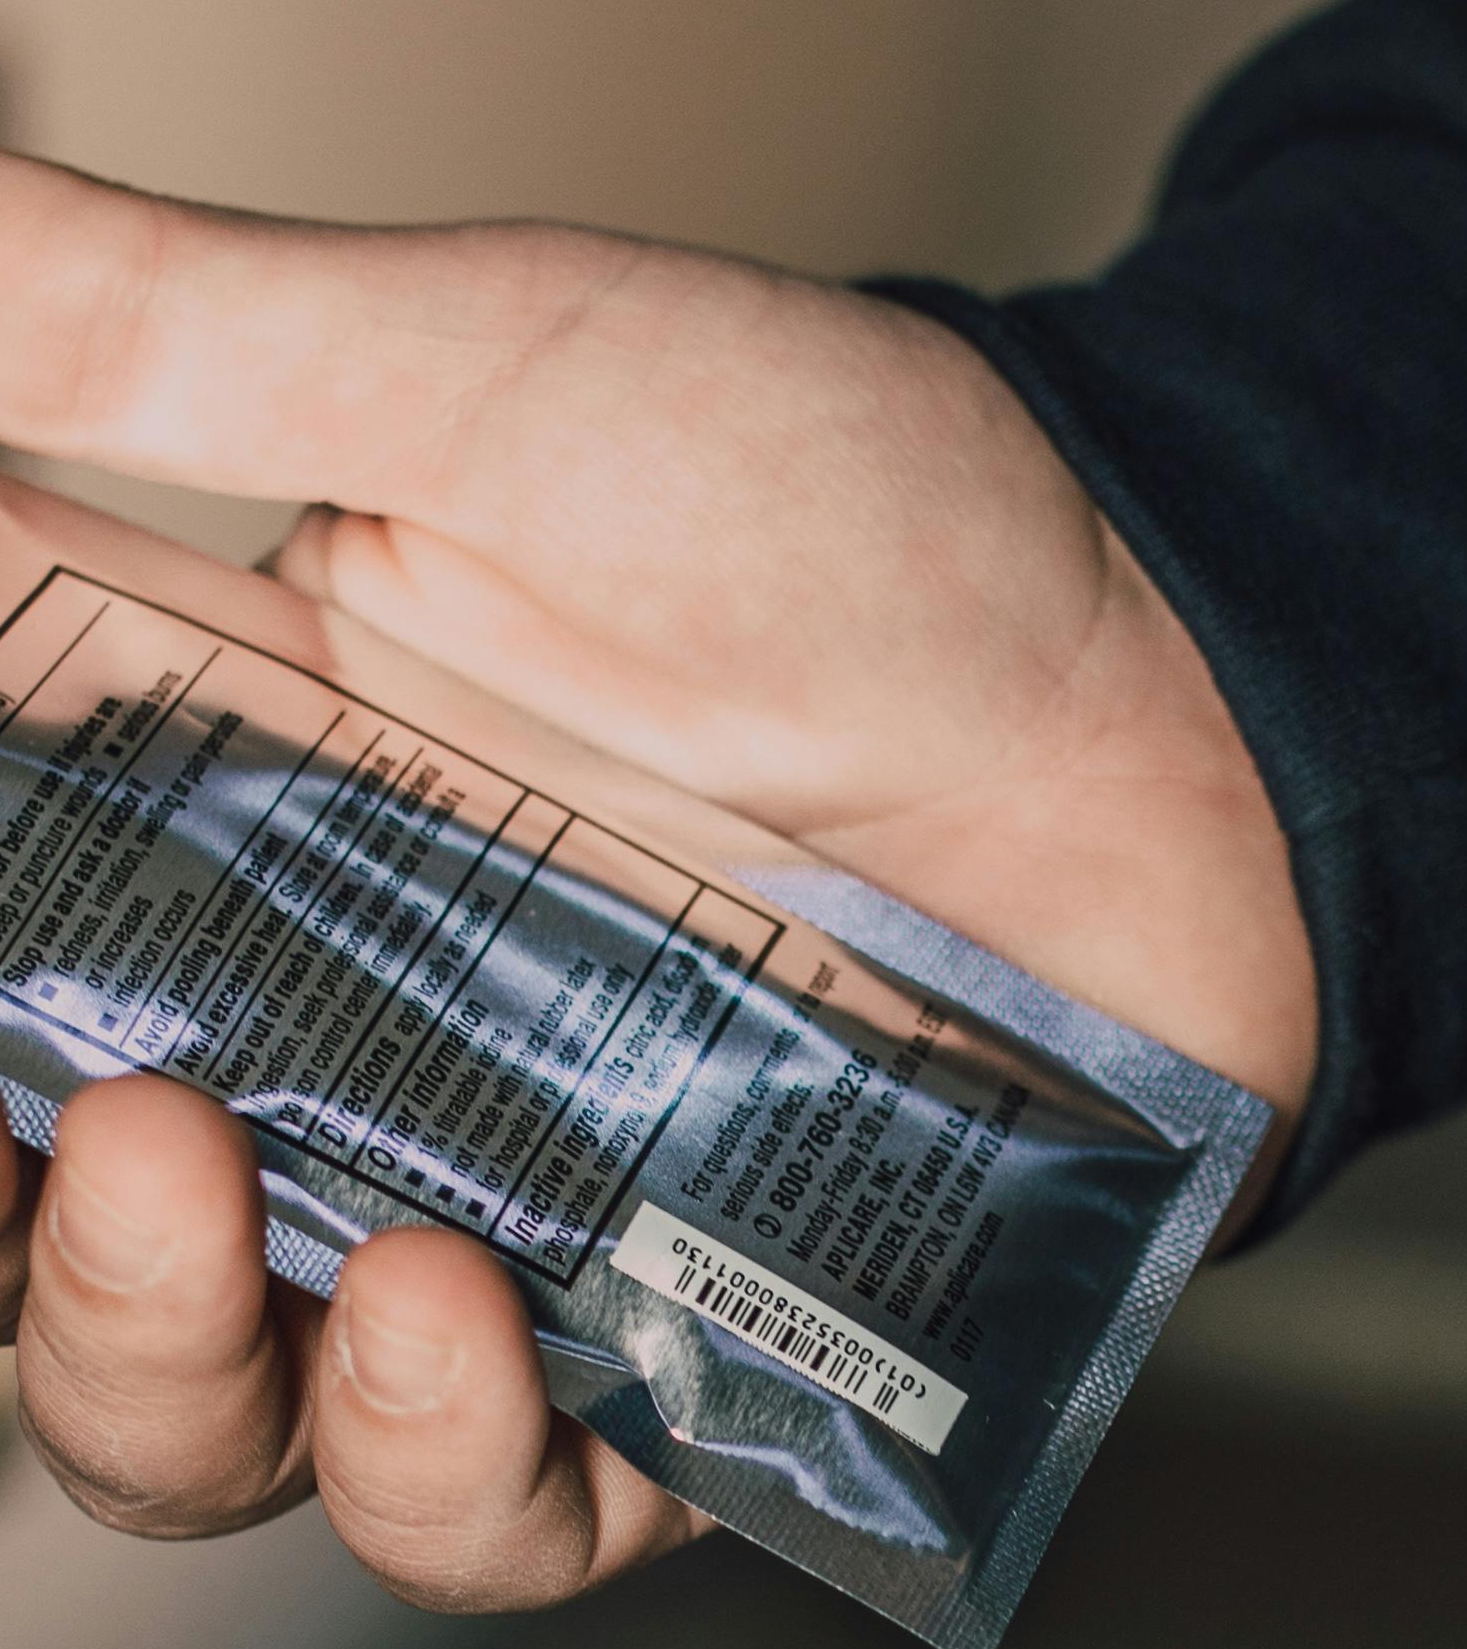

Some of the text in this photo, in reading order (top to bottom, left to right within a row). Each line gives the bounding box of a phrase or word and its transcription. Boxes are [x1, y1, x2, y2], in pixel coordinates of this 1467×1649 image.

[32, 769, 65, 802] use
[46, 754, 73, 775] if
[59, 765, 109, 820] wounds
[1, 775, 153, 989] Stop use and ask a doctor if
[7, 881, 31, 905] or
[18, 816, 83, 890] puncture
[278, 867, 319, 904] Store
[51, 913, 110, 979] redness,
[86, 847, 151, 914] irritation,
[84, 895, 154, 991] or increases
[106, 888, 197, 1009] infection occurs
[130, 832, 288, 1054] Avoid pooling beneath patient
[250, 904, 294, 946] heat.
[302, 929, 327, 955] of
[312, 883, 364, 938] children.
[196, 941, 269, 1026] excessive
[240, 1027, 311, 1112] ingestion,
[292, 991, 329, 1035] seek
[315, 911, 379, 1001] professional
[261, 993, 287, 1020] of
[273, 951, 315, 1001] reach
[587, 993, 614, 1022] use
[173, 1018, 220, 1077] Avoid
[244, 1015, 276, 1050] out
[271, 1068, 322, 1127] poison
[309, 1011, 355, 1071] control
[341, 968, 382, 1019] center
[315, 888, 498, 1151] Directions apply locally as needed
[210, 1048, 260, 1095] Keep
[366, 998, 490, 1172] Other information
[416, 1026, 514, 1160] 1% titratable iodine
[449, 955, 597, 1180] not made with natural rubber latex
[528, 1089, 552, 1113] or
[487, 1104, 542, 1172] hospital
[503, 1156, 573, 1247] Inactive
[552, 1056, 636, 1162] ingredients
[679, 1170, 715, 1204] For
[701, 1102, 763, 1176] questions,
[768, 1048, 878, 1213] 800-760-3236
[910, 1145, 955, 1198] 06450
[474, 1165, 507, 1195] for
[719, 1162, 766, 1223] serious
[748, 1128, 785, 1169] side
[785, 1150, 871, 1264] Monday-Friday
[847, 1115, 886, 1157] 8:30
[897, 1189, 929, 1221] CT
[536, 1178, 609, 1268] phosphate,
[820, 1158, 908, 1284] APLICARE, INC.
[851, 1218, 919, 1302] MERIDEN,
[884, 1224, 958, 1322] BRAMPTON,
[936, 1194, 969, 1229] ON
[971, 1132, 1004, 1169] 4V3
[920, 1209, 1004, 1342] www.aplicare.com
[671, 1237, 927, 1399] (01)00352380001130
[949, 1315, 985, 1364] 0117
